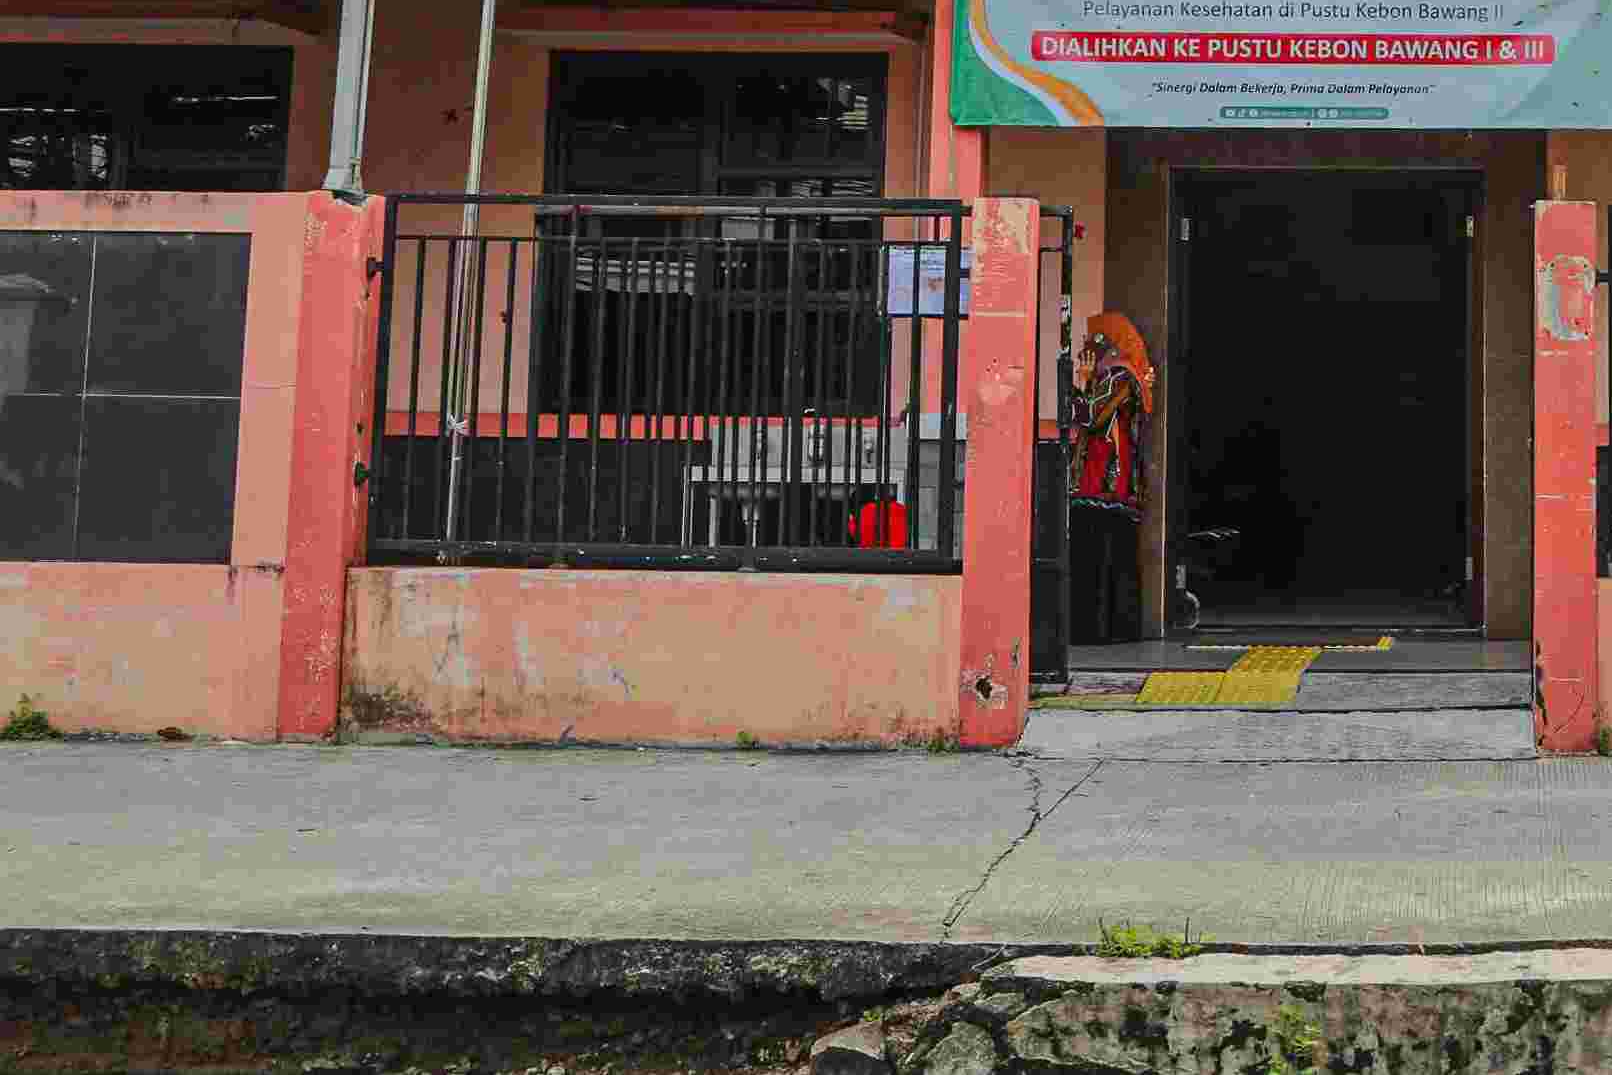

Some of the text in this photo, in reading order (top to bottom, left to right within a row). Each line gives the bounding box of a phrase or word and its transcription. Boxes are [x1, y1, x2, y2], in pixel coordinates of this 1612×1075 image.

[1083, 0, 1504, 23] Pelayanan Kesehatan di Pustu Kebon Bawang II
[1041, 37, 1544, 59] DIALIHKAN KE PUSTU KEBON BAWANG I & III
[1200, 82, 1237, 94] Dalam
[1290, 83, 1325, 94] Prima
[1328, 83, 1366, 94] Dalam
